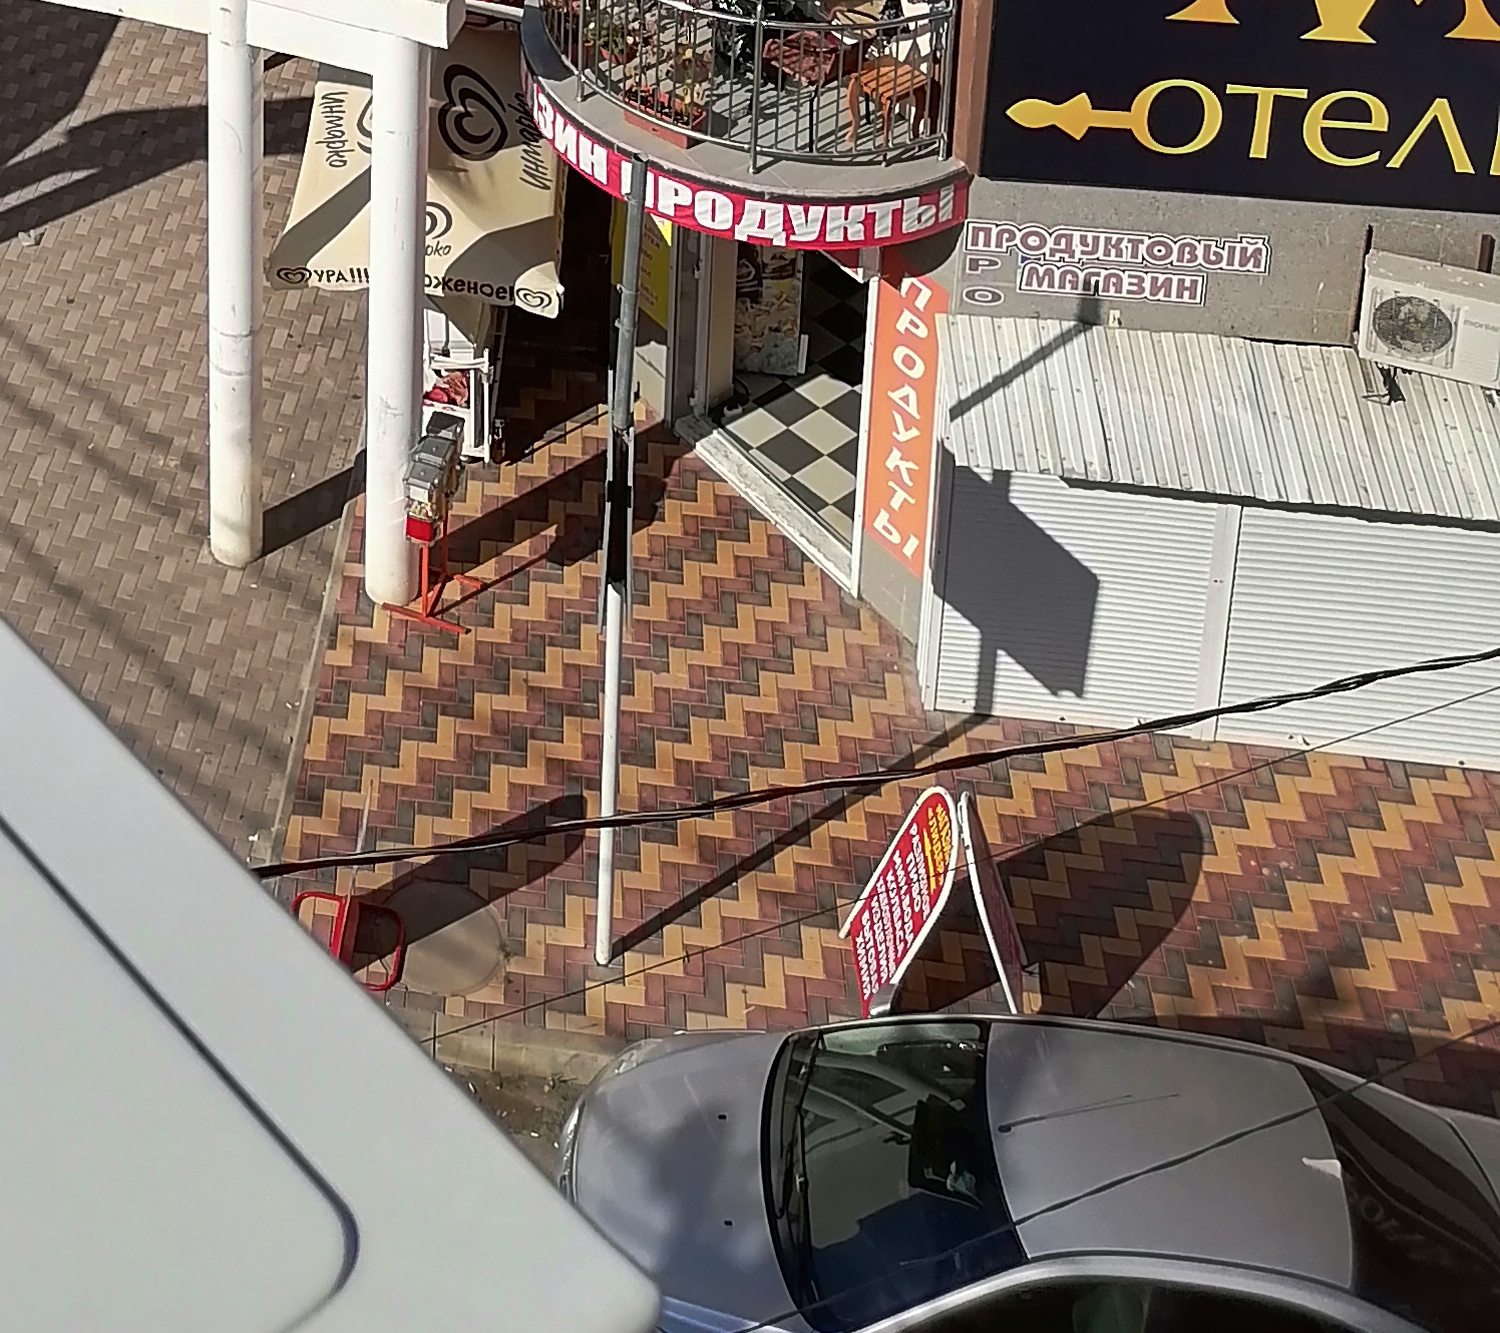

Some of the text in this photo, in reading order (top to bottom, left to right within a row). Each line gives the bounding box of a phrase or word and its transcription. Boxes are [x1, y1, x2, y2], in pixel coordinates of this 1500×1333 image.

[968, 223, 1266, 271] ПРОДУКТОВЫЙ
[425, 273, 515, 301] оженое!
[1023, 264, 1200, 303] МАГАЗИН
[873, 276, 933, 559] ПРОДУКТЫ
[886, 869, 904, 958] КОЛБАСА
[906, 851, 922, 913] ПИВО
[855, 930, 871, 1001] ХИМИЯ
[871, 895, 888, 984] ИЗДЕЛИЯ
